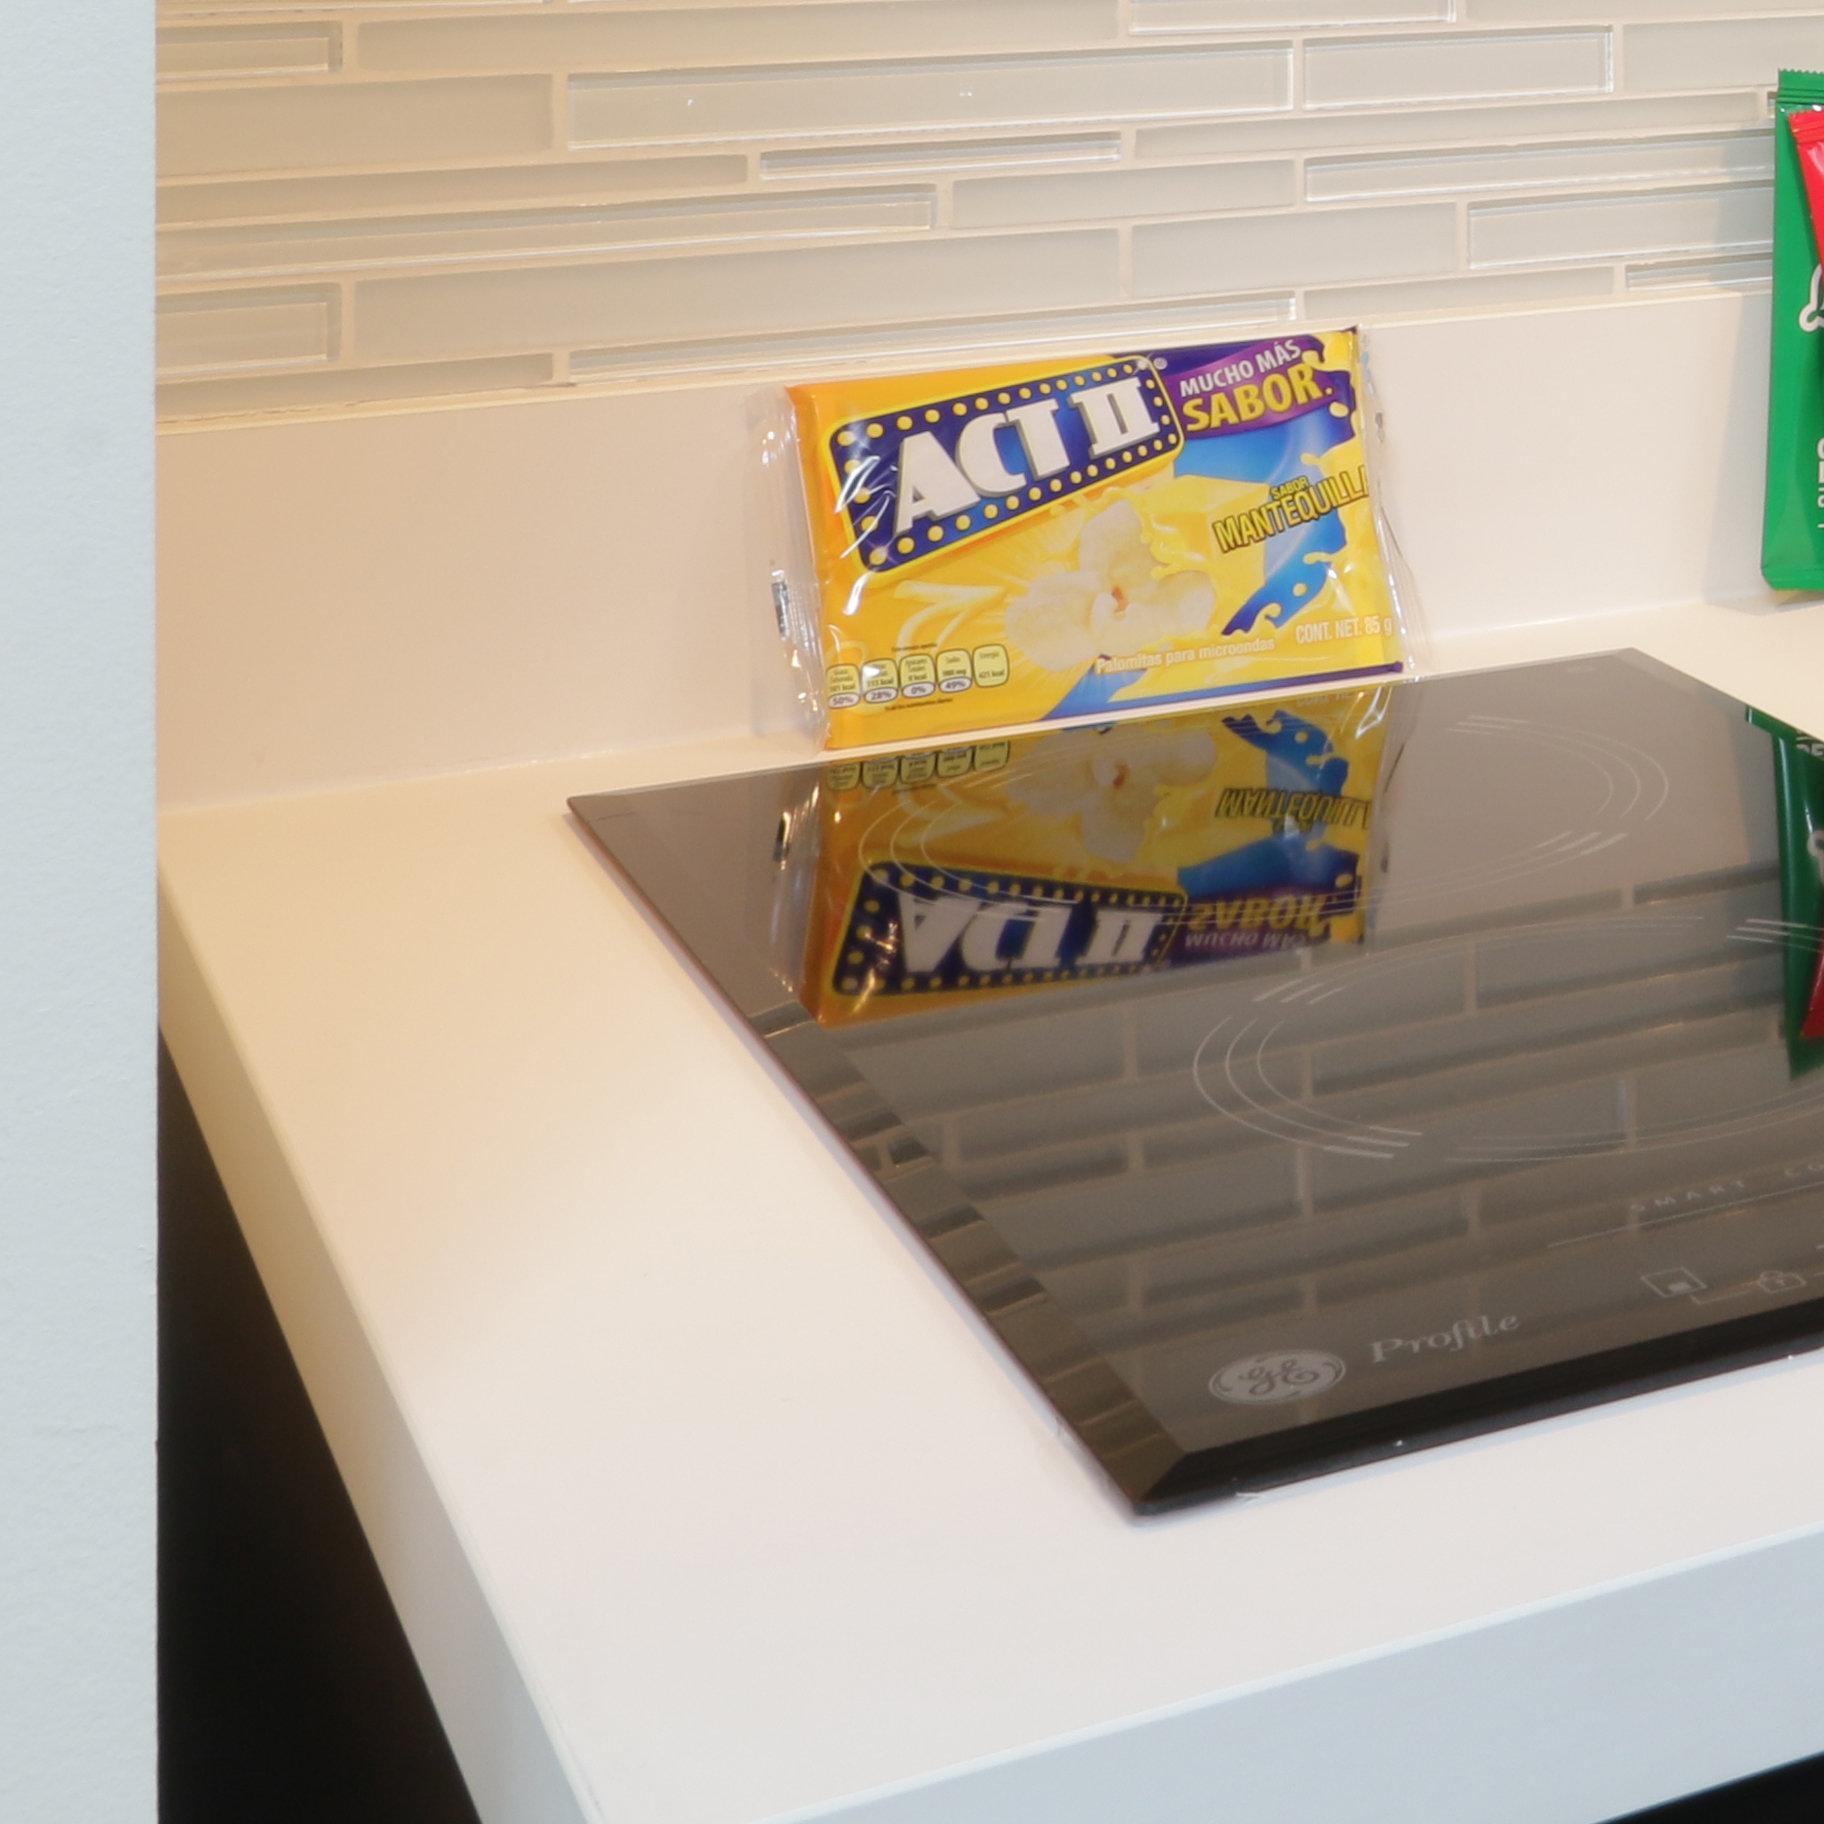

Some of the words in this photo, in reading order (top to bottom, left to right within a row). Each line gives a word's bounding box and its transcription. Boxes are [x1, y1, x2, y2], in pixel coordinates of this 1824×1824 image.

[1179, 359, 1254, 397] MUCHO
[1255, 339, 1301, 373] MÁS
[893, 397, 1071, 537] ACT
[1068, 375, 1161, 459] II
[1269, 475, 1310, 500] SABOR
[1295, 623, 1332, 644] CONT.
[1335, 620, 1361, 640] NET.
[1364, 617, 1381, 635] 85
[1384, 619, 1393, 636] g
[1095, 651, 1162, 674] Palomitas
[1165, 648, 1196, 666] para
[1199, 637, 1275, 660] microondas
[1368, 1314, 1520, 1364] Profile
